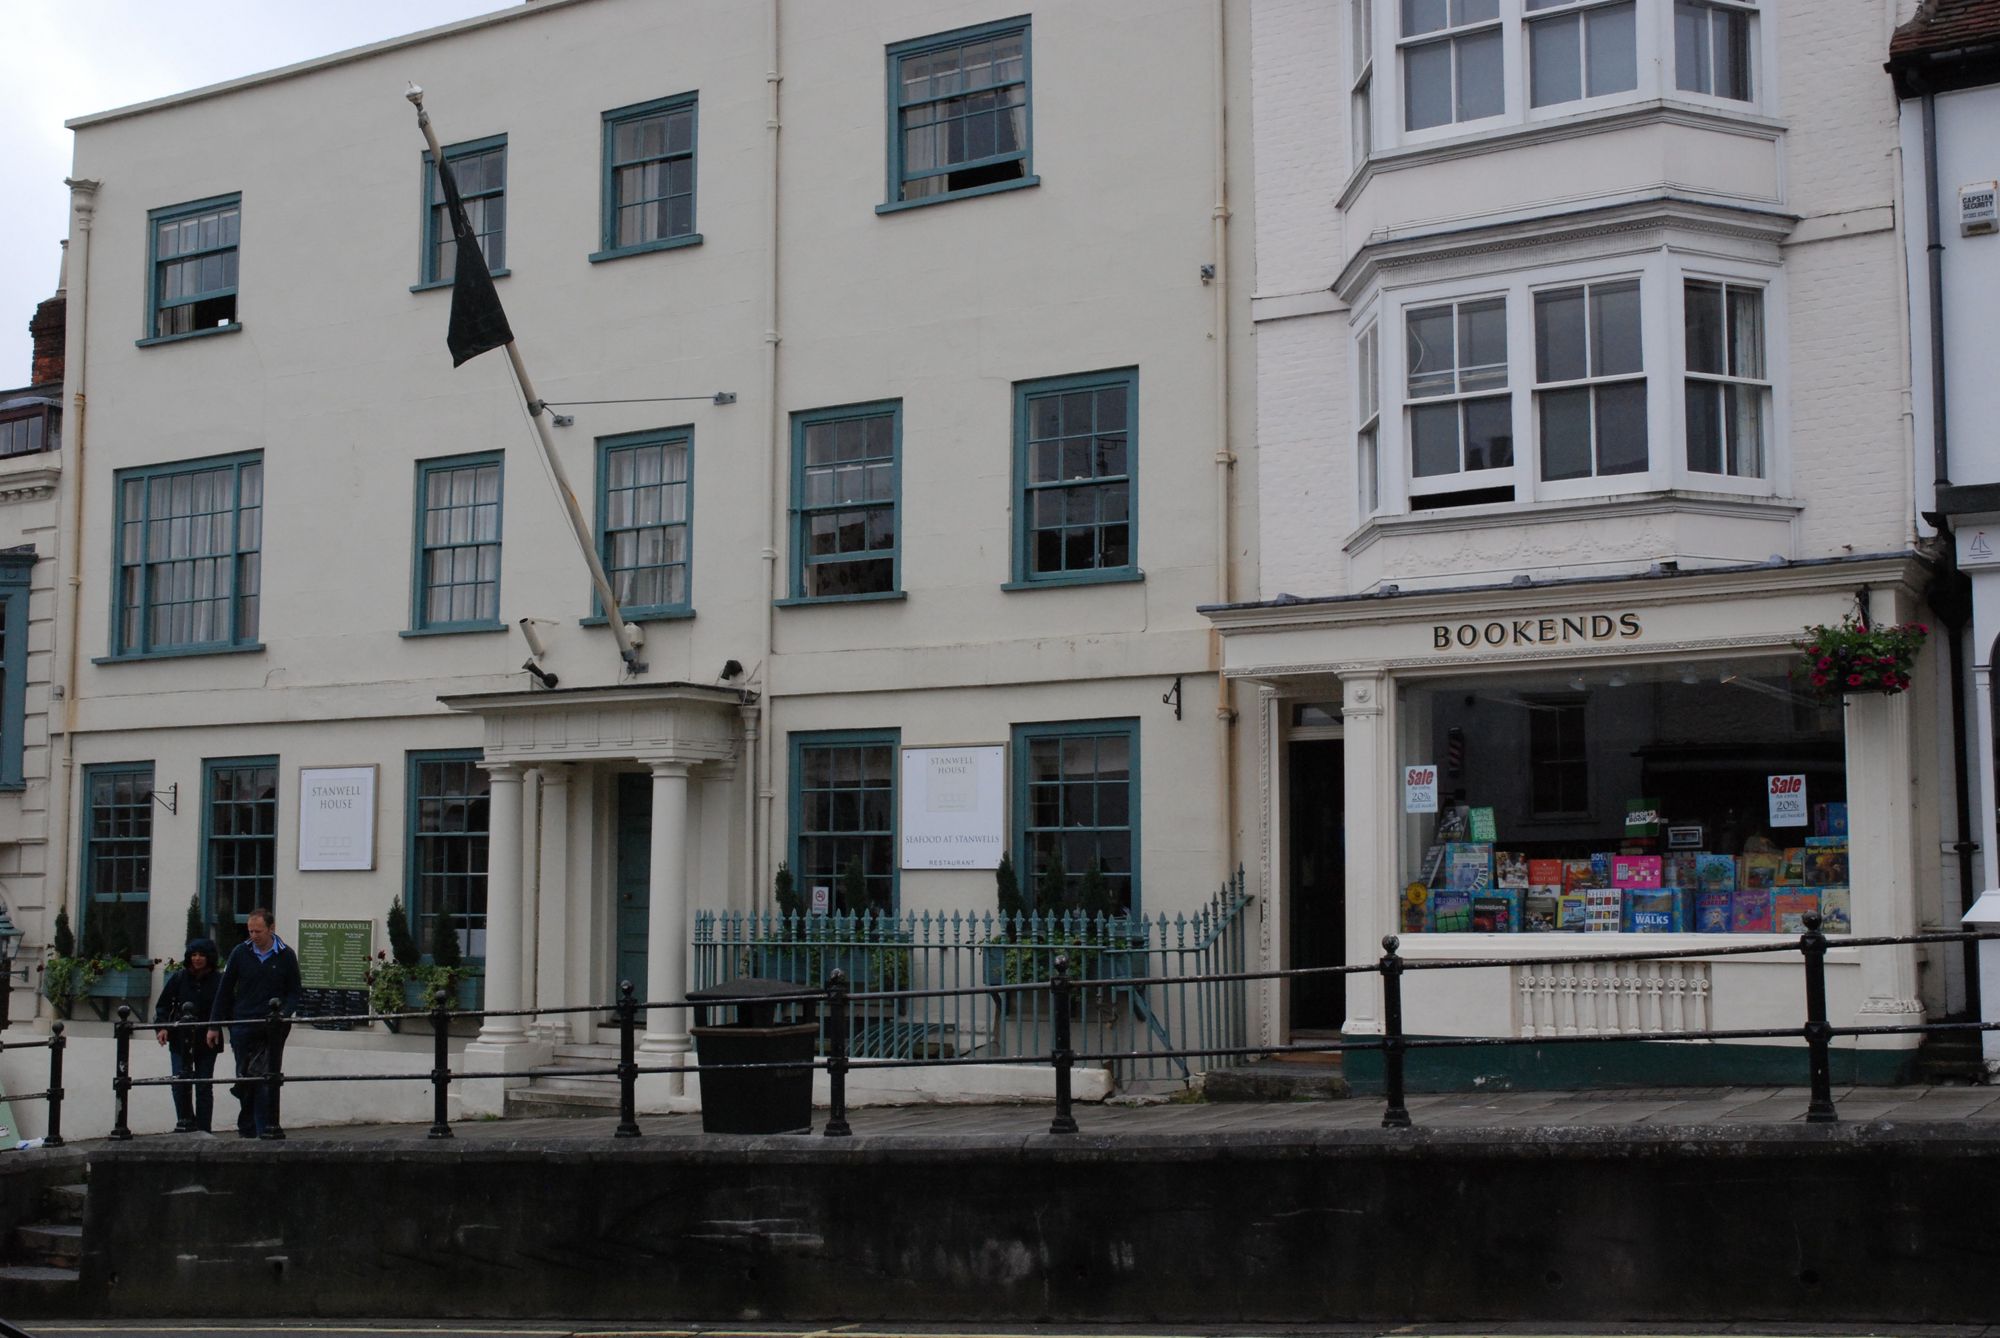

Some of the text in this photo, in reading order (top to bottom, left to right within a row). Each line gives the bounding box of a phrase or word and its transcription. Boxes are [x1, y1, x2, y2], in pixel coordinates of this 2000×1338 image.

[1962, 194, 1993, 205] CAPSTAN
[1962, 201, 1993, 211] SECURITY
[1433, 613, 1643, 652] BOOKENDS
[930, 756, 974, 766] STANWELL
[938, 767, 967, 775] HOUSE
[1407, 769, 1434, 786] Sale
[1770, 776, 1802, 794] Sale
[312, 786, 361, 797] STANWELL
[1412, 792, 1431, 801] 20%
[320, 799, 352, 810] HOUSE
[1776, 800, 1800, 810] 20%
[905, 833, 1000, 845] SEAFOOD AT STANWELLS
[928, 858, 975, 866] RESTAURANT
[1635, 915, 1669, 924] WALKS
[300, 922, 329, 930] SEAFOOD
[337, 922, 370, 930] STANWELL
